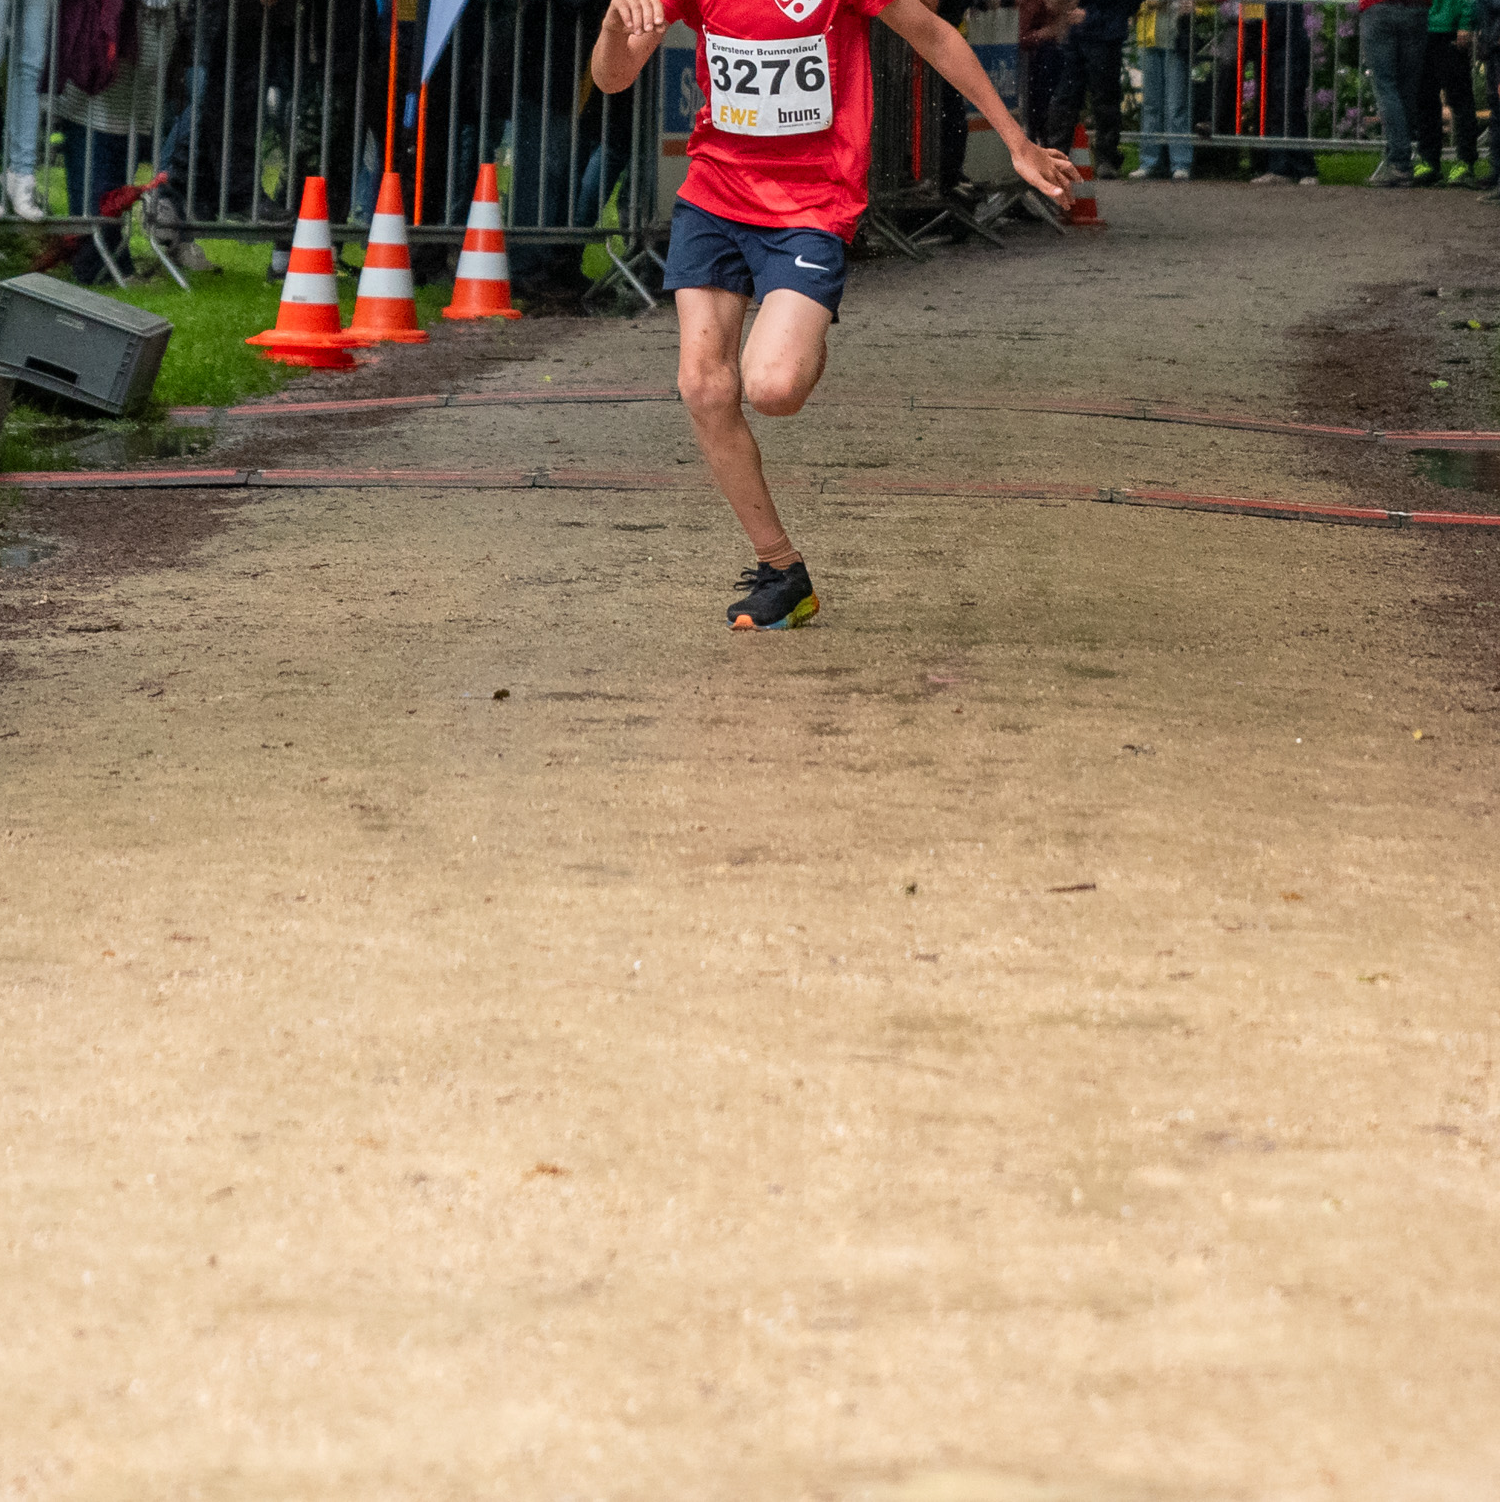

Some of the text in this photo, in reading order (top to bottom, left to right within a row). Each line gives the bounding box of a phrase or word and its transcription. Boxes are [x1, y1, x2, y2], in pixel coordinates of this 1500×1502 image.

[712, 43, 818, 56] Everstener Brunnenlauf
[711, 55, 825, 95] 3276
[719, 105, 758, 127] EWE
[778, 108, 820, 123] bruns
